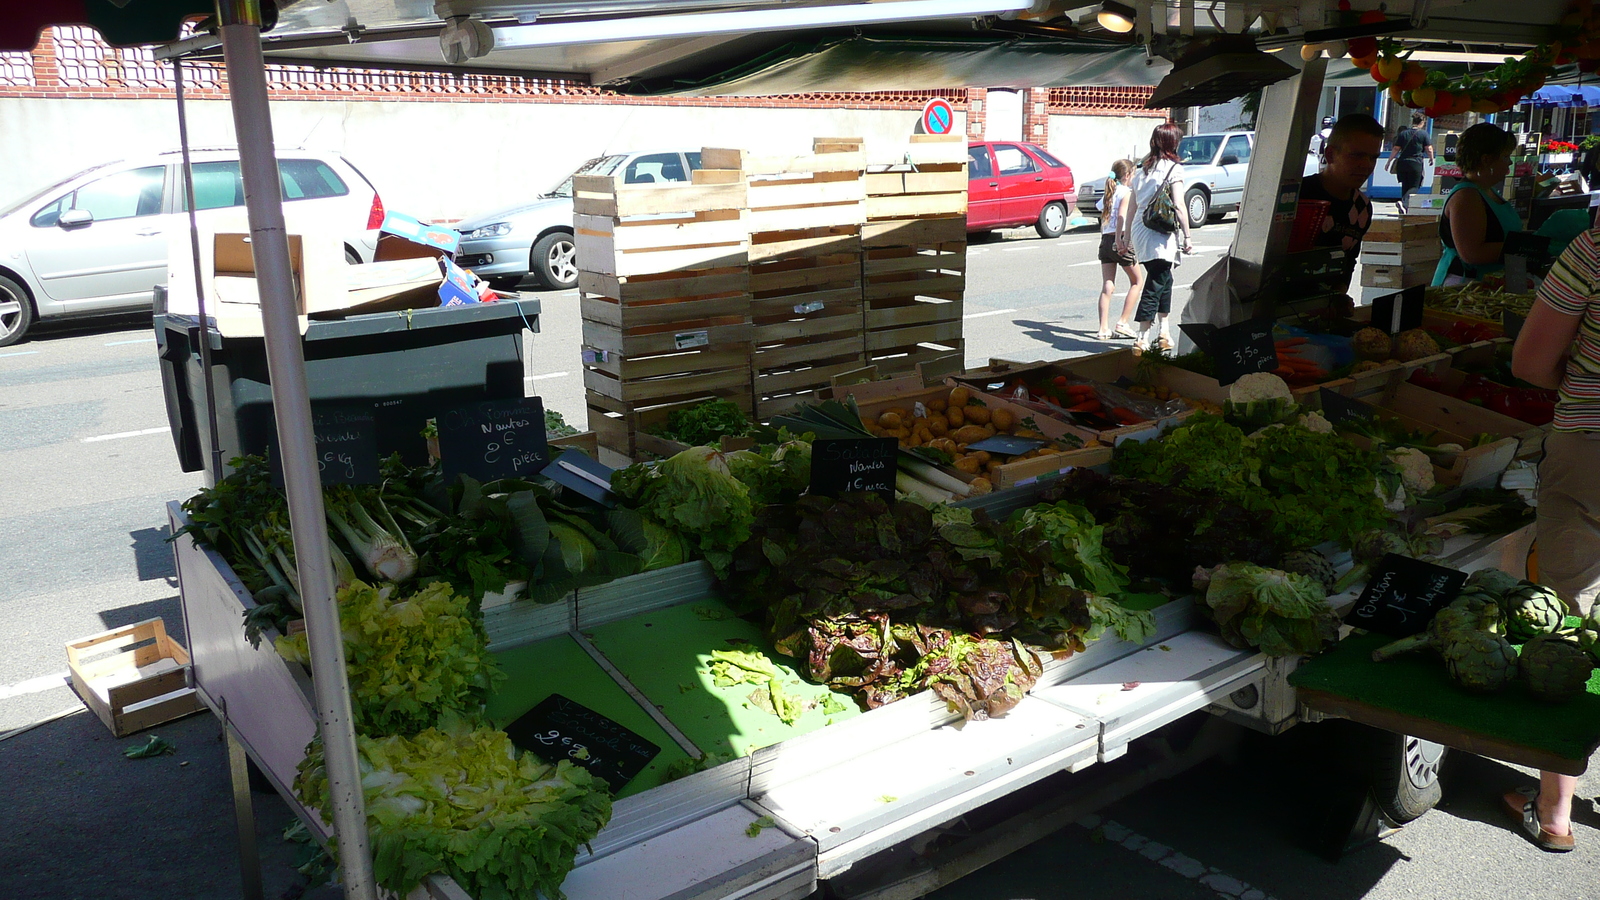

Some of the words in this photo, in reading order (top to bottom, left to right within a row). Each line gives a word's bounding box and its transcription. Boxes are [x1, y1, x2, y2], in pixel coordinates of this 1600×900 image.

[1233, 345, 1259, 365] 3,50
[480, 418, 530, 434] Nantes
[512, 448, 543, 471] pièce
[849, 460, 885, 474] Nantes
